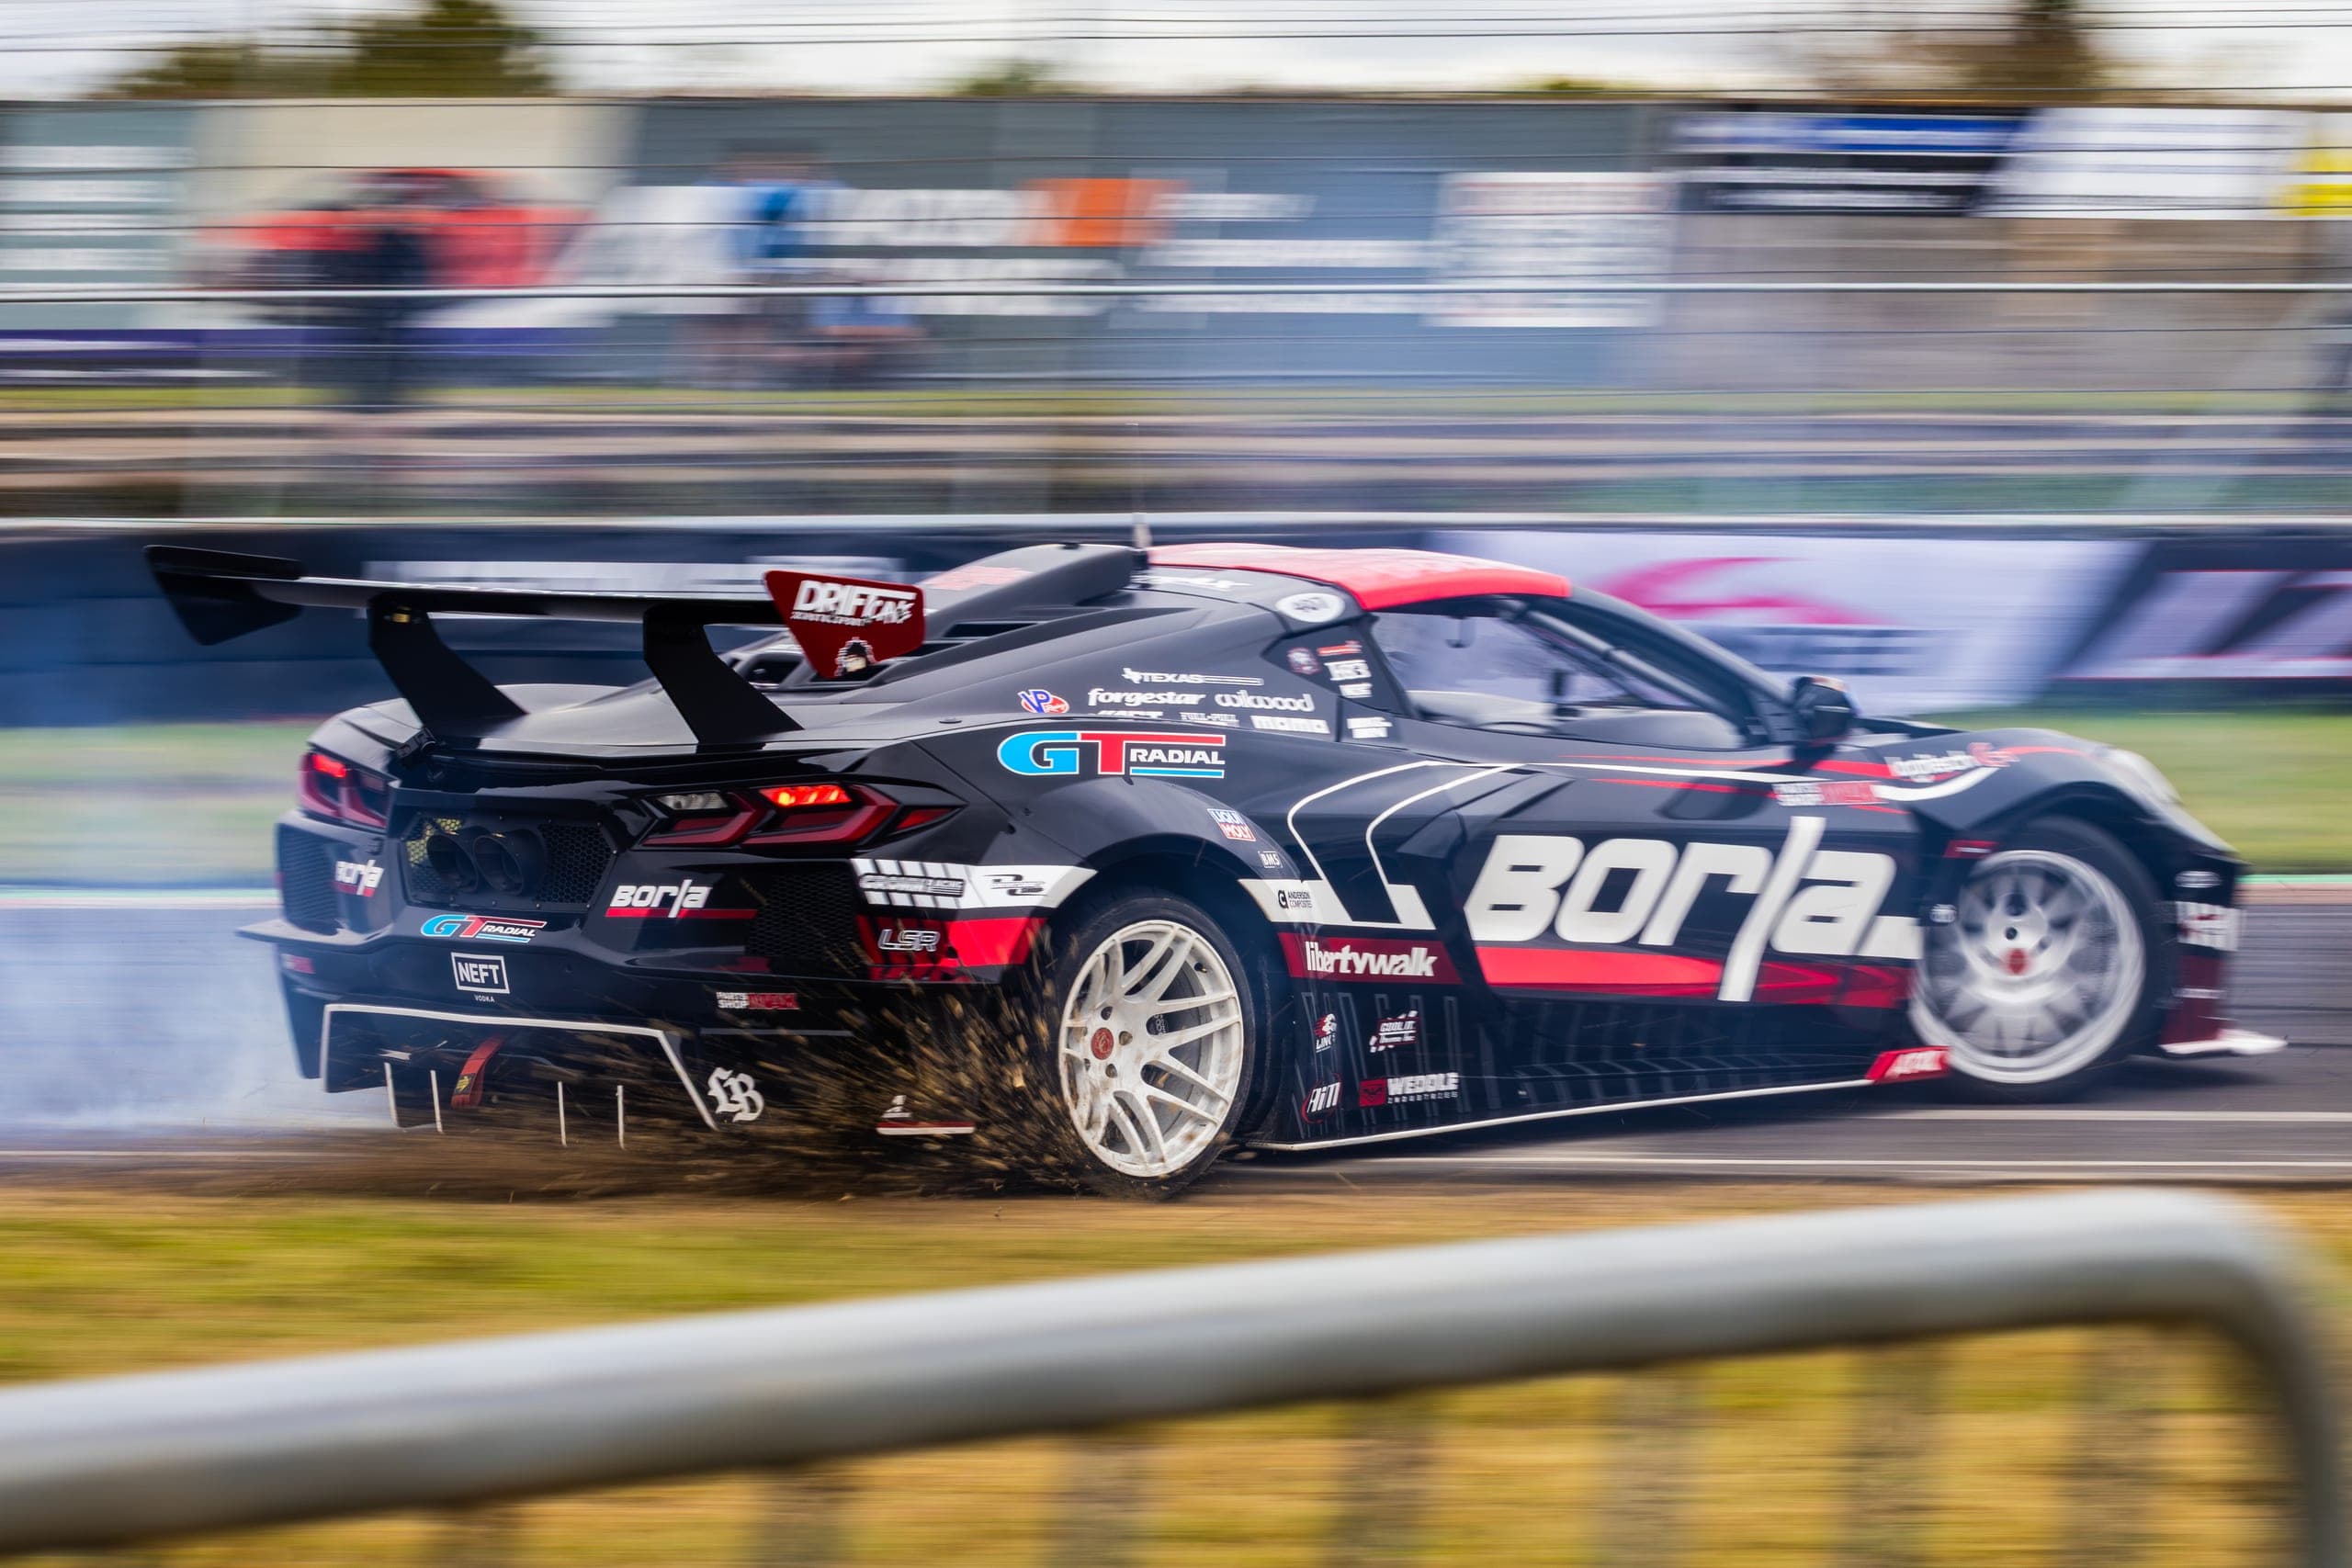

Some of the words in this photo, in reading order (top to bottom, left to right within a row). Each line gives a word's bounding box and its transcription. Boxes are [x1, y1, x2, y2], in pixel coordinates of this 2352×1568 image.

[1142, 672, 1204, 683] TEXAS
[1088, 688, 1205, 706] forgestar
[998, 730, 1139, 776] GT
[1130, 749, 1226, 764] RADIAL
[1221, 823, 1253, 839] MOLY
[421, 914, 494, 938] GT
[481, 924, 536, 937] RADIAL
[877, 929, 941, 952] LSR
[1306, 941, 1438, 976] libertywalk
[458, 962, 500, 985] NEFT
[473, 994, 495, 1003] VODKA
